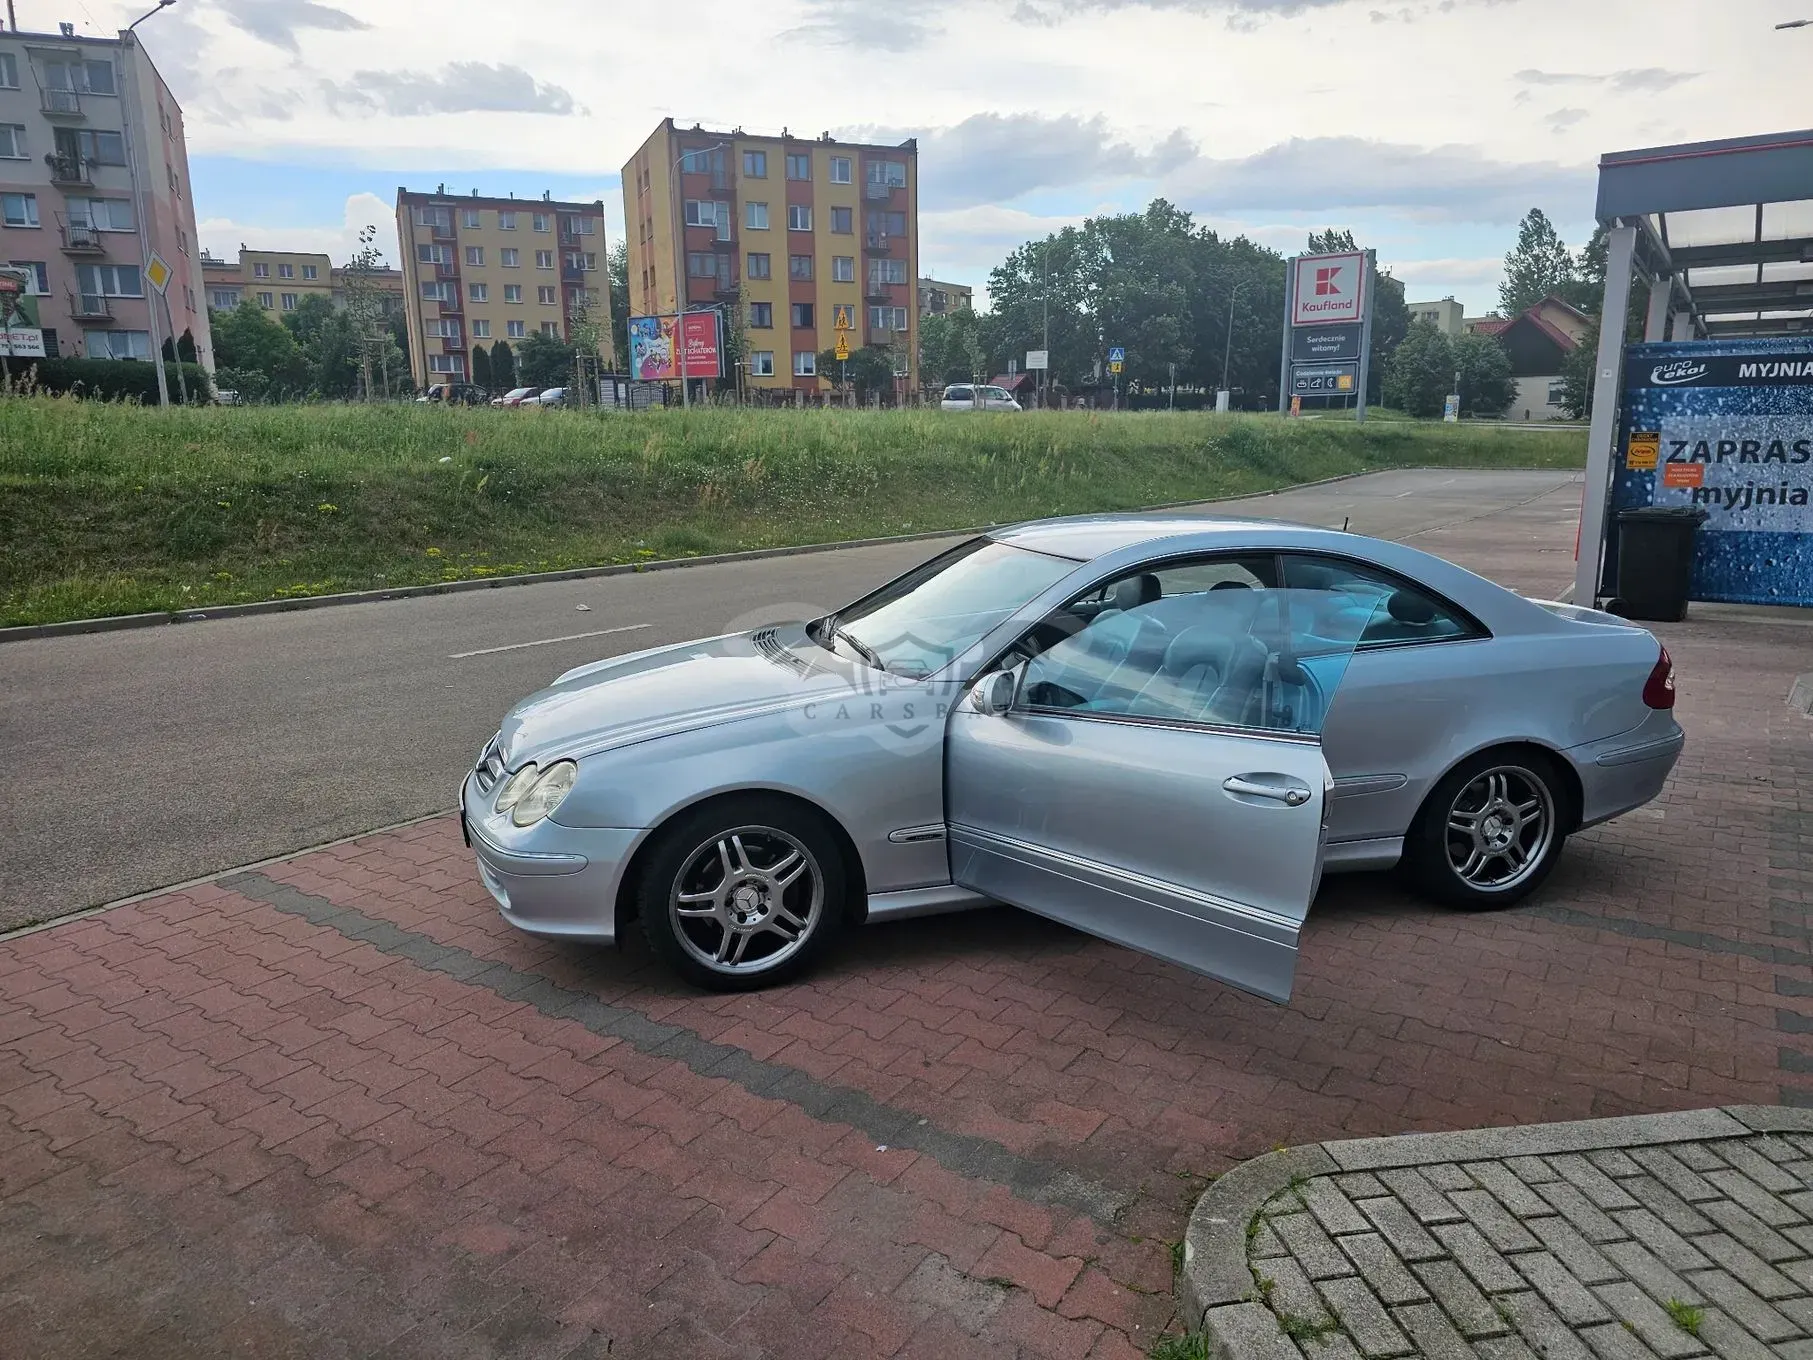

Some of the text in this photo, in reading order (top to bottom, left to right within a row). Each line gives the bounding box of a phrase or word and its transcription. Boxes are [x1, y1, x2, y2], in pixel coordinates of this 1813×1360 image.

[1302, 299, 1353, 312] Kaufland
[1306, 335, 1346, 343] Serdecznie
[1311, 344, 1340, 352] witamy!
[1654, 360, 1692, 373] euro
[1664, 364, 1705, 379] ekol
[1738, 361, 1813, 378] MYJNIA
[1666, 440, 1811, 464] ZAPRAS
[1691, 481, 1809, 511] myjnia
